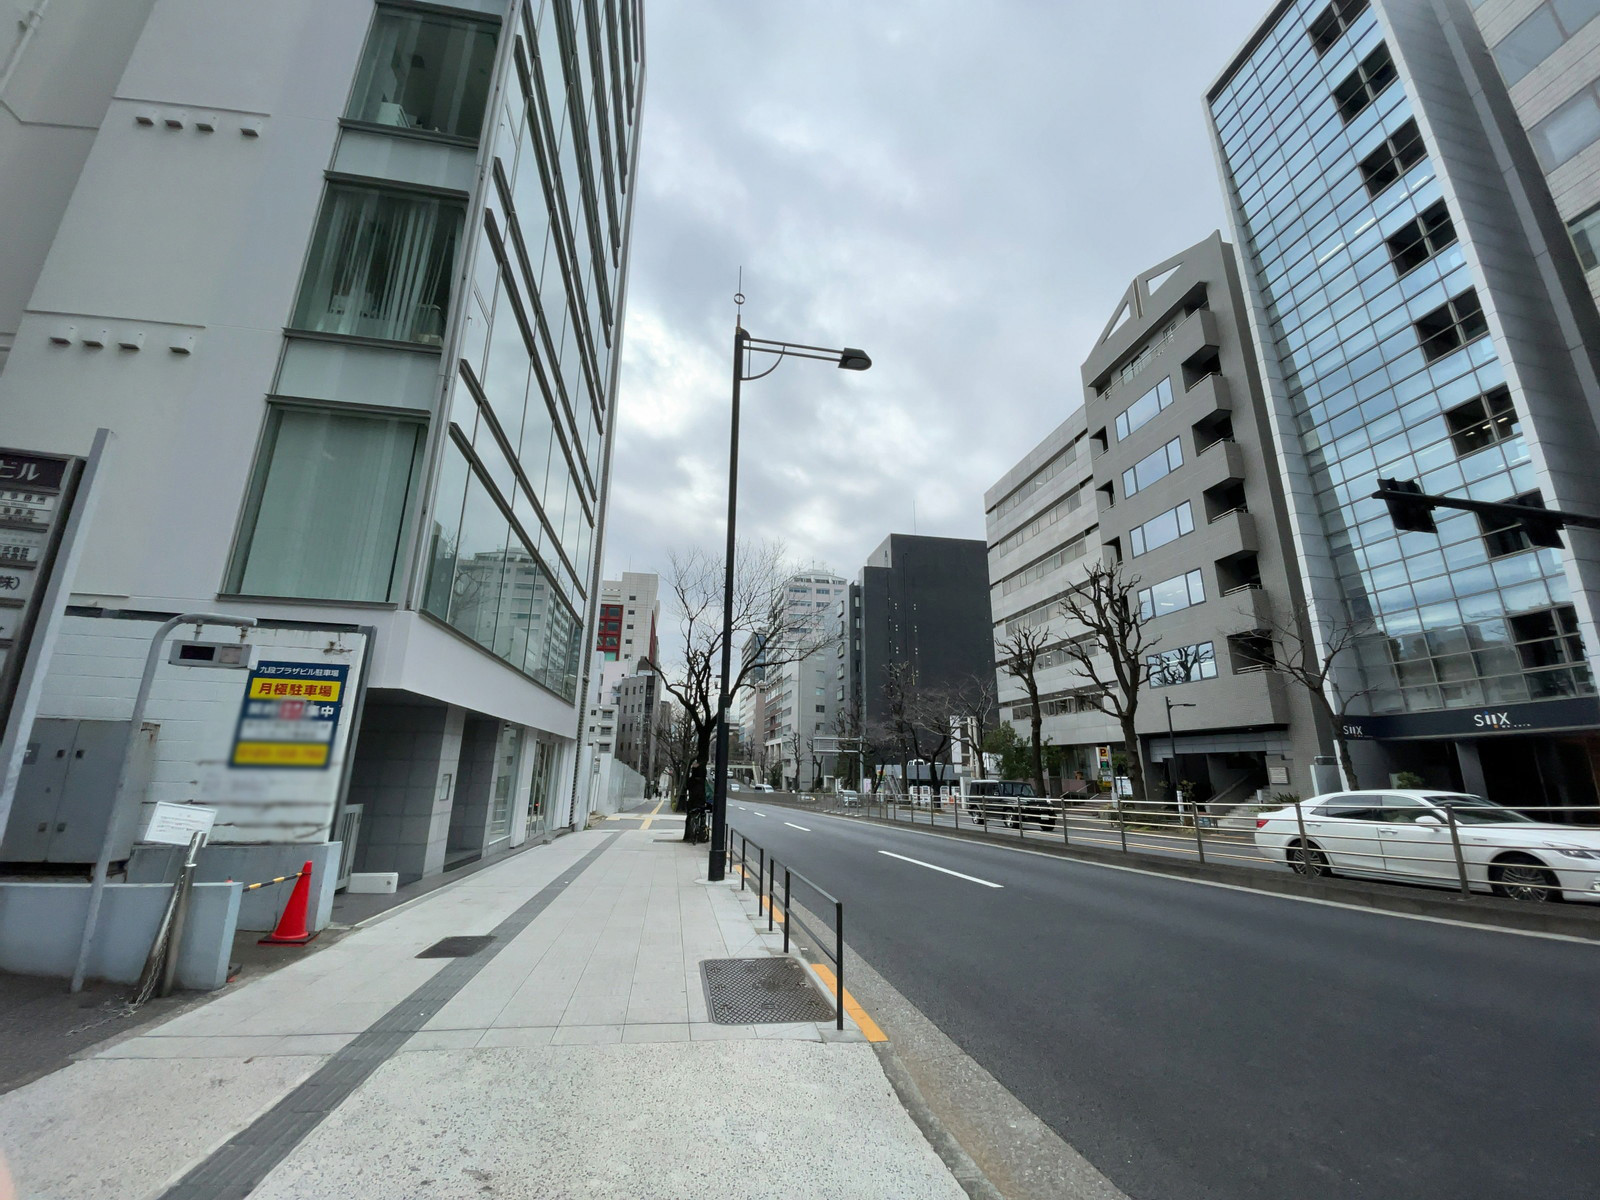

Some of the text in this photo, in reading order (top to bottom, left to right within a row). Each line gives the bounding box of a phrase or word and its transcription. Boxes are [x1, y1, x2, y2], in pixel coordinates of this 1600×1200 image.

[258, 666, 340, 677] 九段プラザビル駐車場
[258, 682, 333, 697] 月極駐車場
